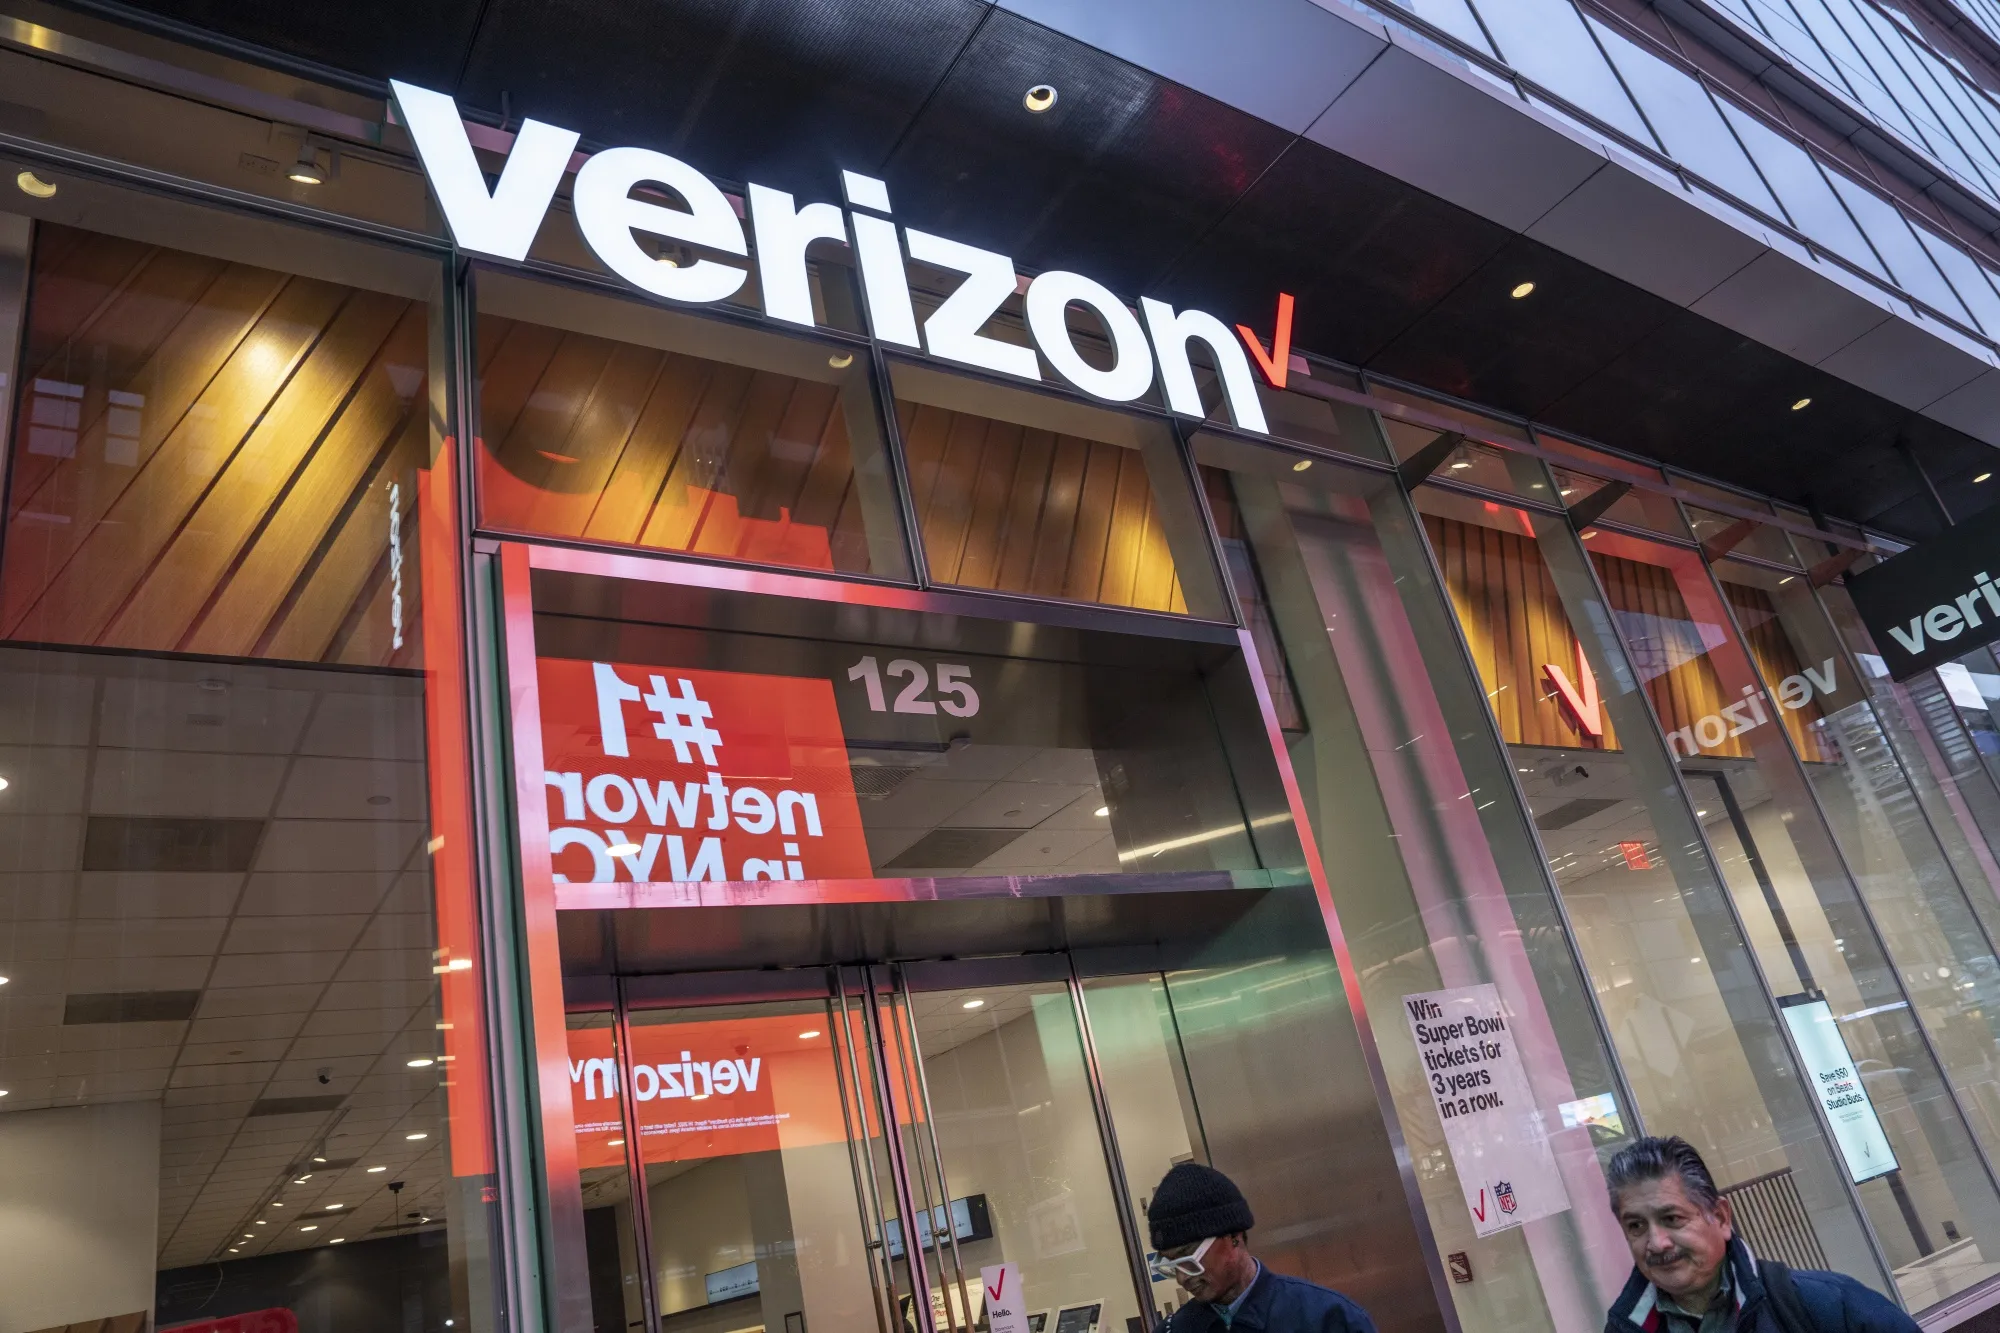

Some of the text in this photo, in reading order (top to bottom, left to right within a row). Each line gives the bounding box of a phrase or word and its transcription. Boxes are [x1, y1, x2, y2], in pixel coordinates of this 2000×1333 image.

[389, 79, 1270, 435] verizon
[1887, 571, 2000, 656] veri
[848, 656, 980, 718] 125
[1406, 998, 1443, 1022] Win
[1415, 1021, 1464, 1046] Super
[1424, 1040, 1502, 1071] tickets for
[1431, 1069, 1491, 1097] 3 years
[1438, 1091, 1504, 1119] in a row.
[1499, 1194, 1516, 1211] NFL
[992, 1309, 1012, 1319] Hello.
